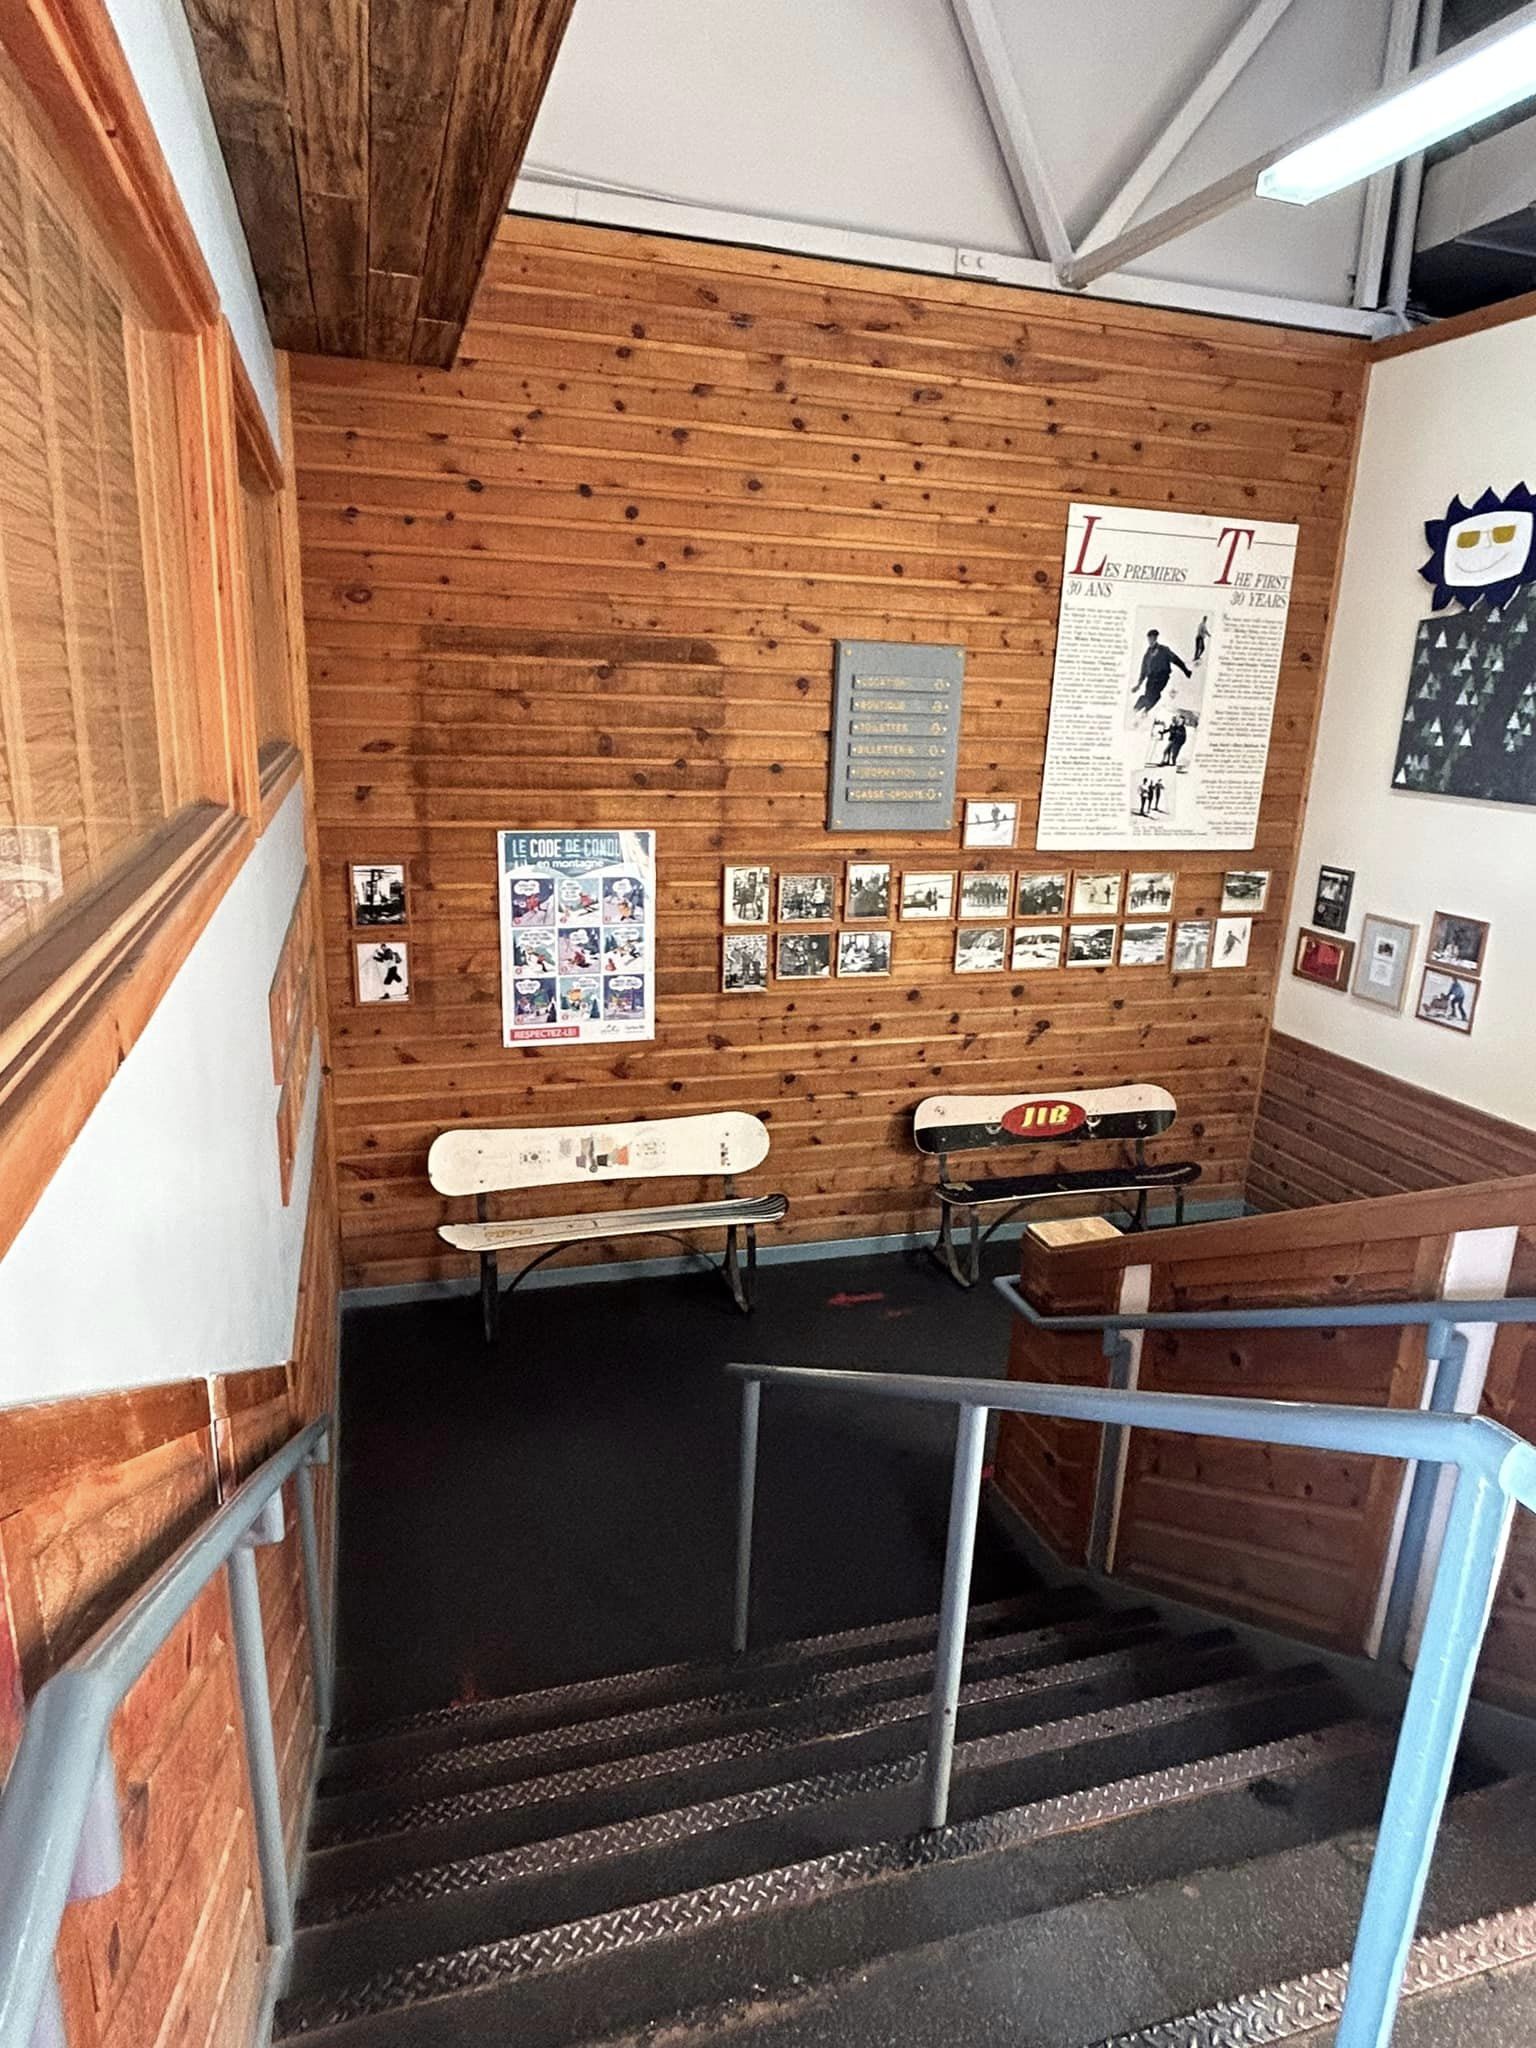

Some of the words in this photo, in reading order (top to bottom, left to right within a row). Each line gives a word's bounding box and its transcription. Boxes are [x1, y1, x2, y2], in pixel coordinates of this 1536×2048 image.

[1068, 515, 1121, 577] LES
[1123, 562, 1189, 583] PREMIERS
[1213, 527, 1256, 586] THE
[1254, 573, 1291, 591] FIRST
[1065, 580, 1082, 596] 30
[1086, 582, 1114, 599] ANS
[1230, 592, 1245, 606] 30
[1249, 592, 1289, 609] YEARS
[512, 838, 527, 858] LE
[530, 838, 562, 858] CODE
[565, 838, 582, 853] DE
[536, 860, 550, 870] en
[552, 859, 605, 871] montagne
[1021, 1104, 1071, 1128] JIB
